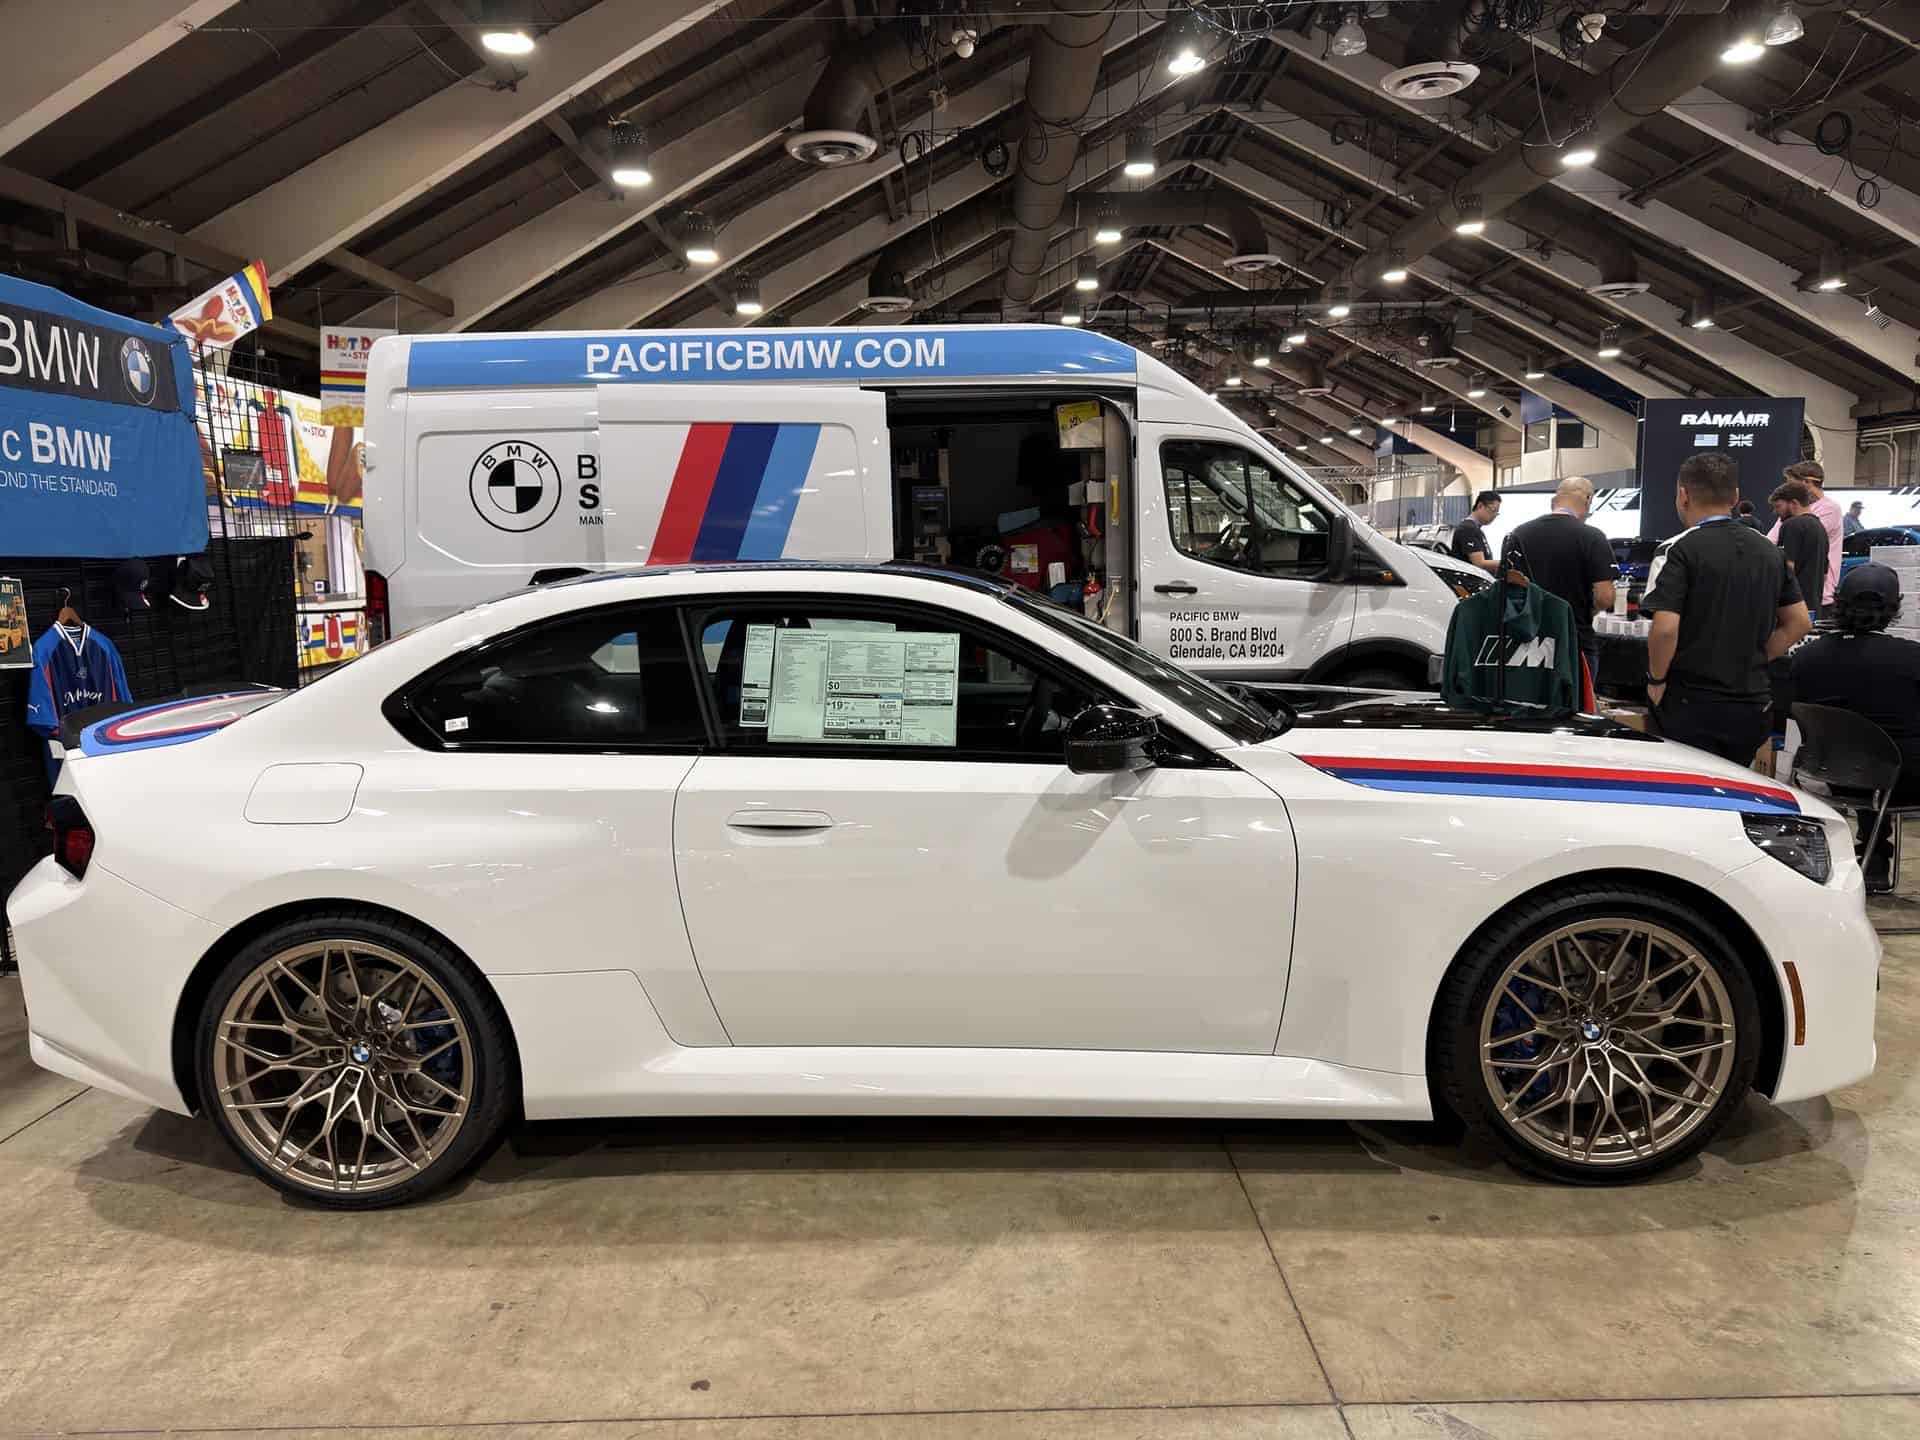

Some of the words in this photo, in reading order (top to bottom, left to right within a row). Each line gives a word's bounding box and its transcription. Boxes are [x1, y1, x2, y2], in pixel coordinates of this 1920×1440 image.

[0, 314, 100, 389] BMW
[585, 338, 945, 373] PACIFICBMW.COM
[1680, 410, 1770, 426] RAMAIR
[29, 422, 112, 472] BMW
[481, 445, 549, 470] BMW
[30, 473, 58, 492] THE
[60, 476, 118, 497] STANDARD
[1169, 611, 1210, 622] PACIFIC
[1213, 611, 1240, 621] BMW
[1170, 628, 1193, 642] 800
[1195, 628, 1207, 642] S.
[1211, 627, 1247, 642] Brand
[1251, 627, 1277, 641] Blvd
[1169, 645, 1225, 660] Glendale,
[1229, 644, 1247, 658] CA
[1250, 643, 1285, 658] 91204
